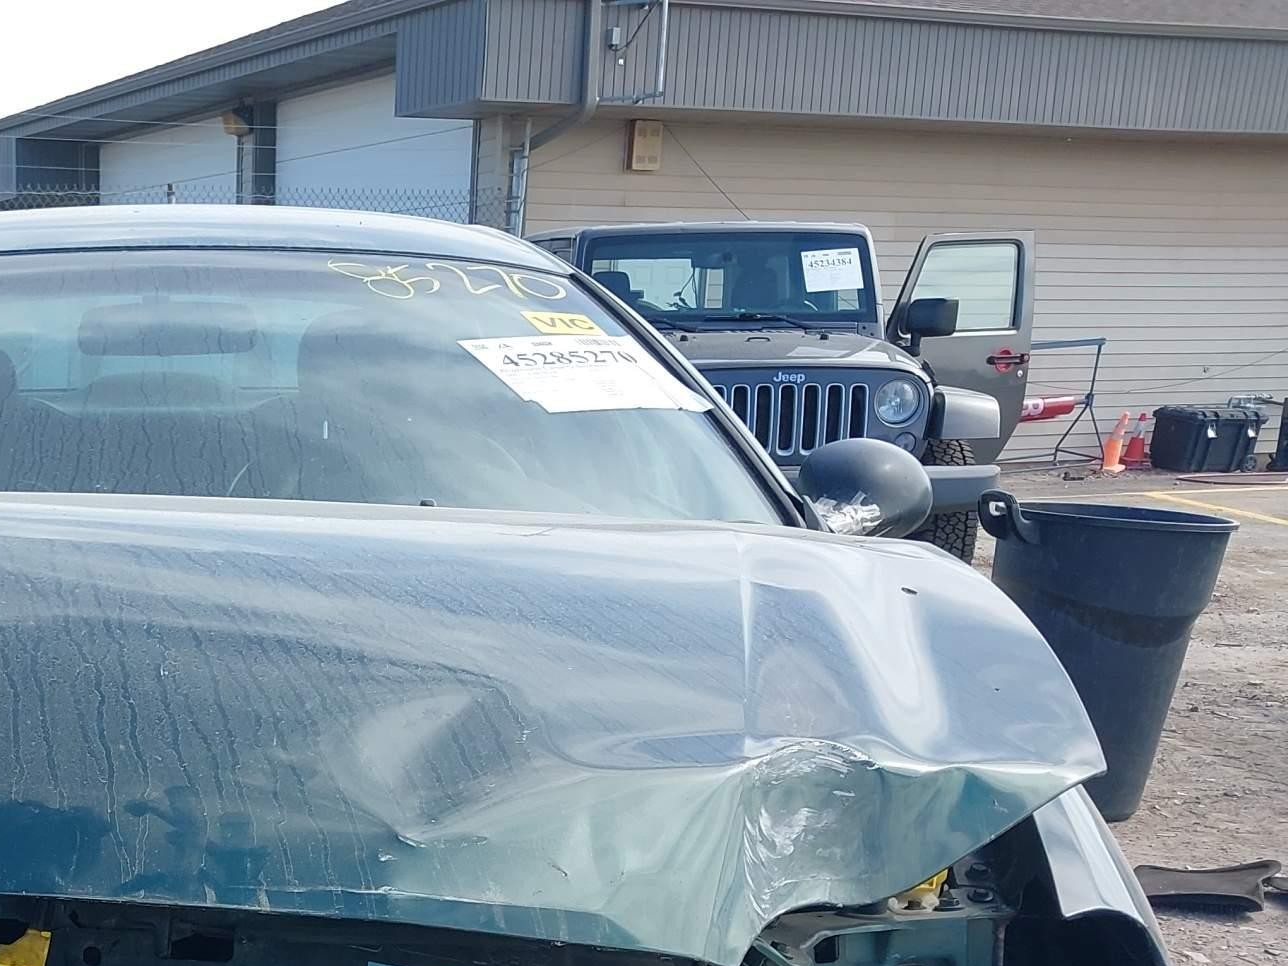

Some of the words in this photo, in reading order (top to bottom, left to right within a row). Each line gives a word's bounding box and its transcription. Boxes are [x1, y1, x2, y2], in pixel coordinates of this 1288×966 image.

[808, 258, 853, 268] 45234384
[327, 258, 568, 300] 85270
[532, 315, 596, 332] VIC
[501, 350, 639, 367] 45285270
[772, 371, 806, 384] Jeep
